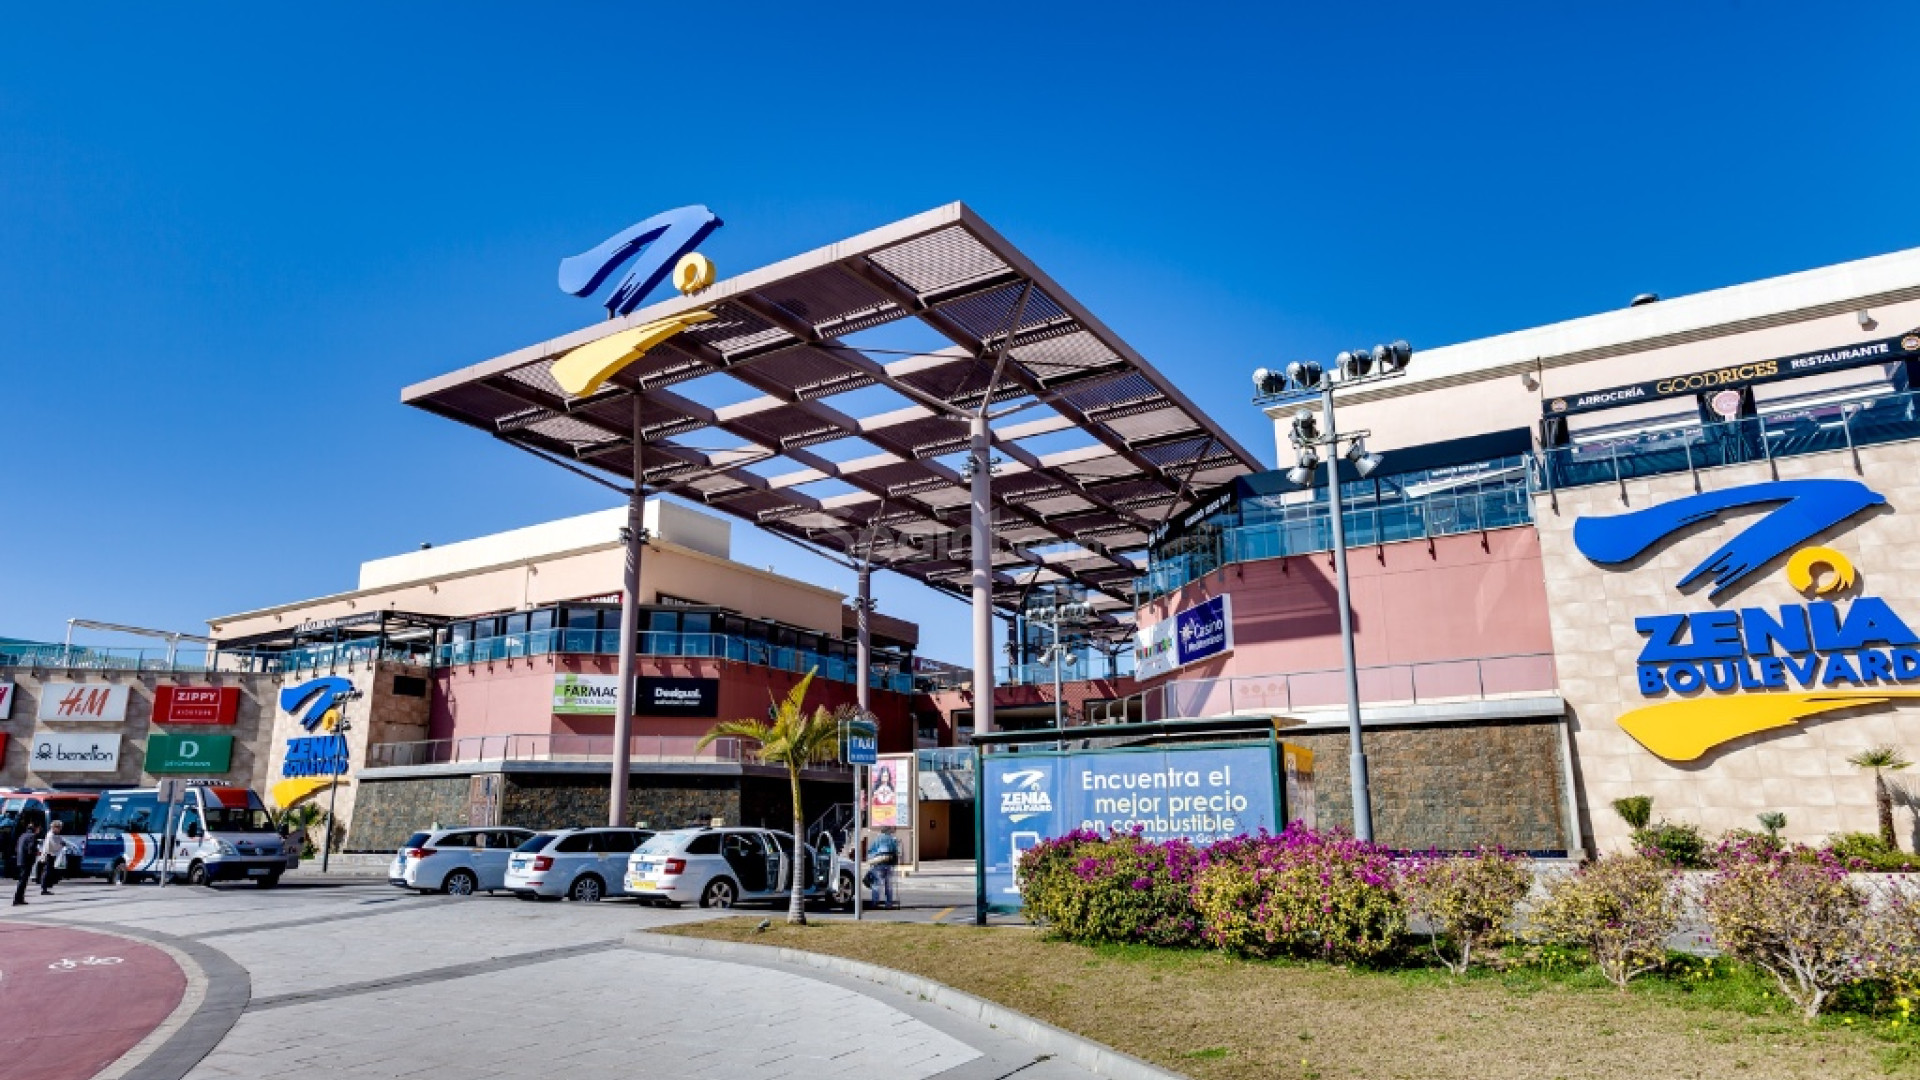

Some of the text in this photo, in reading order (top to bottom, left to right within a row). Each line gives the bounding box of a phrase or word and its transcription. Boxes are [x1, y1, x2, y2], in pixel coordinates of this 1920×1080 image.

[1577, 343, 1889, 407] ARROCERÍA GOODRICES RESTAURANTE
[1194, 618, 1224, 639] Casino
[1634, 596, 1920, 662] ZENIA
[1636, 649, 1920, 695] BOULEVARD
[177, 692, 217, 701] ZIPPY
[563, 684, 617, 699] FARMAC
[57, 687, 111, 717] H&M
[56, 743, 113, 761] benetton
[179, 740, 200, 759] D
[852, 735, 875, 750] TAXI
[1081, 765, 1231, 790] Encuentra el
[1001, 791, 1051, 805] ZENIA
[1095, 790, 1248, 818] mejor precio
[1081, 814, 1236, 833] en combustible
